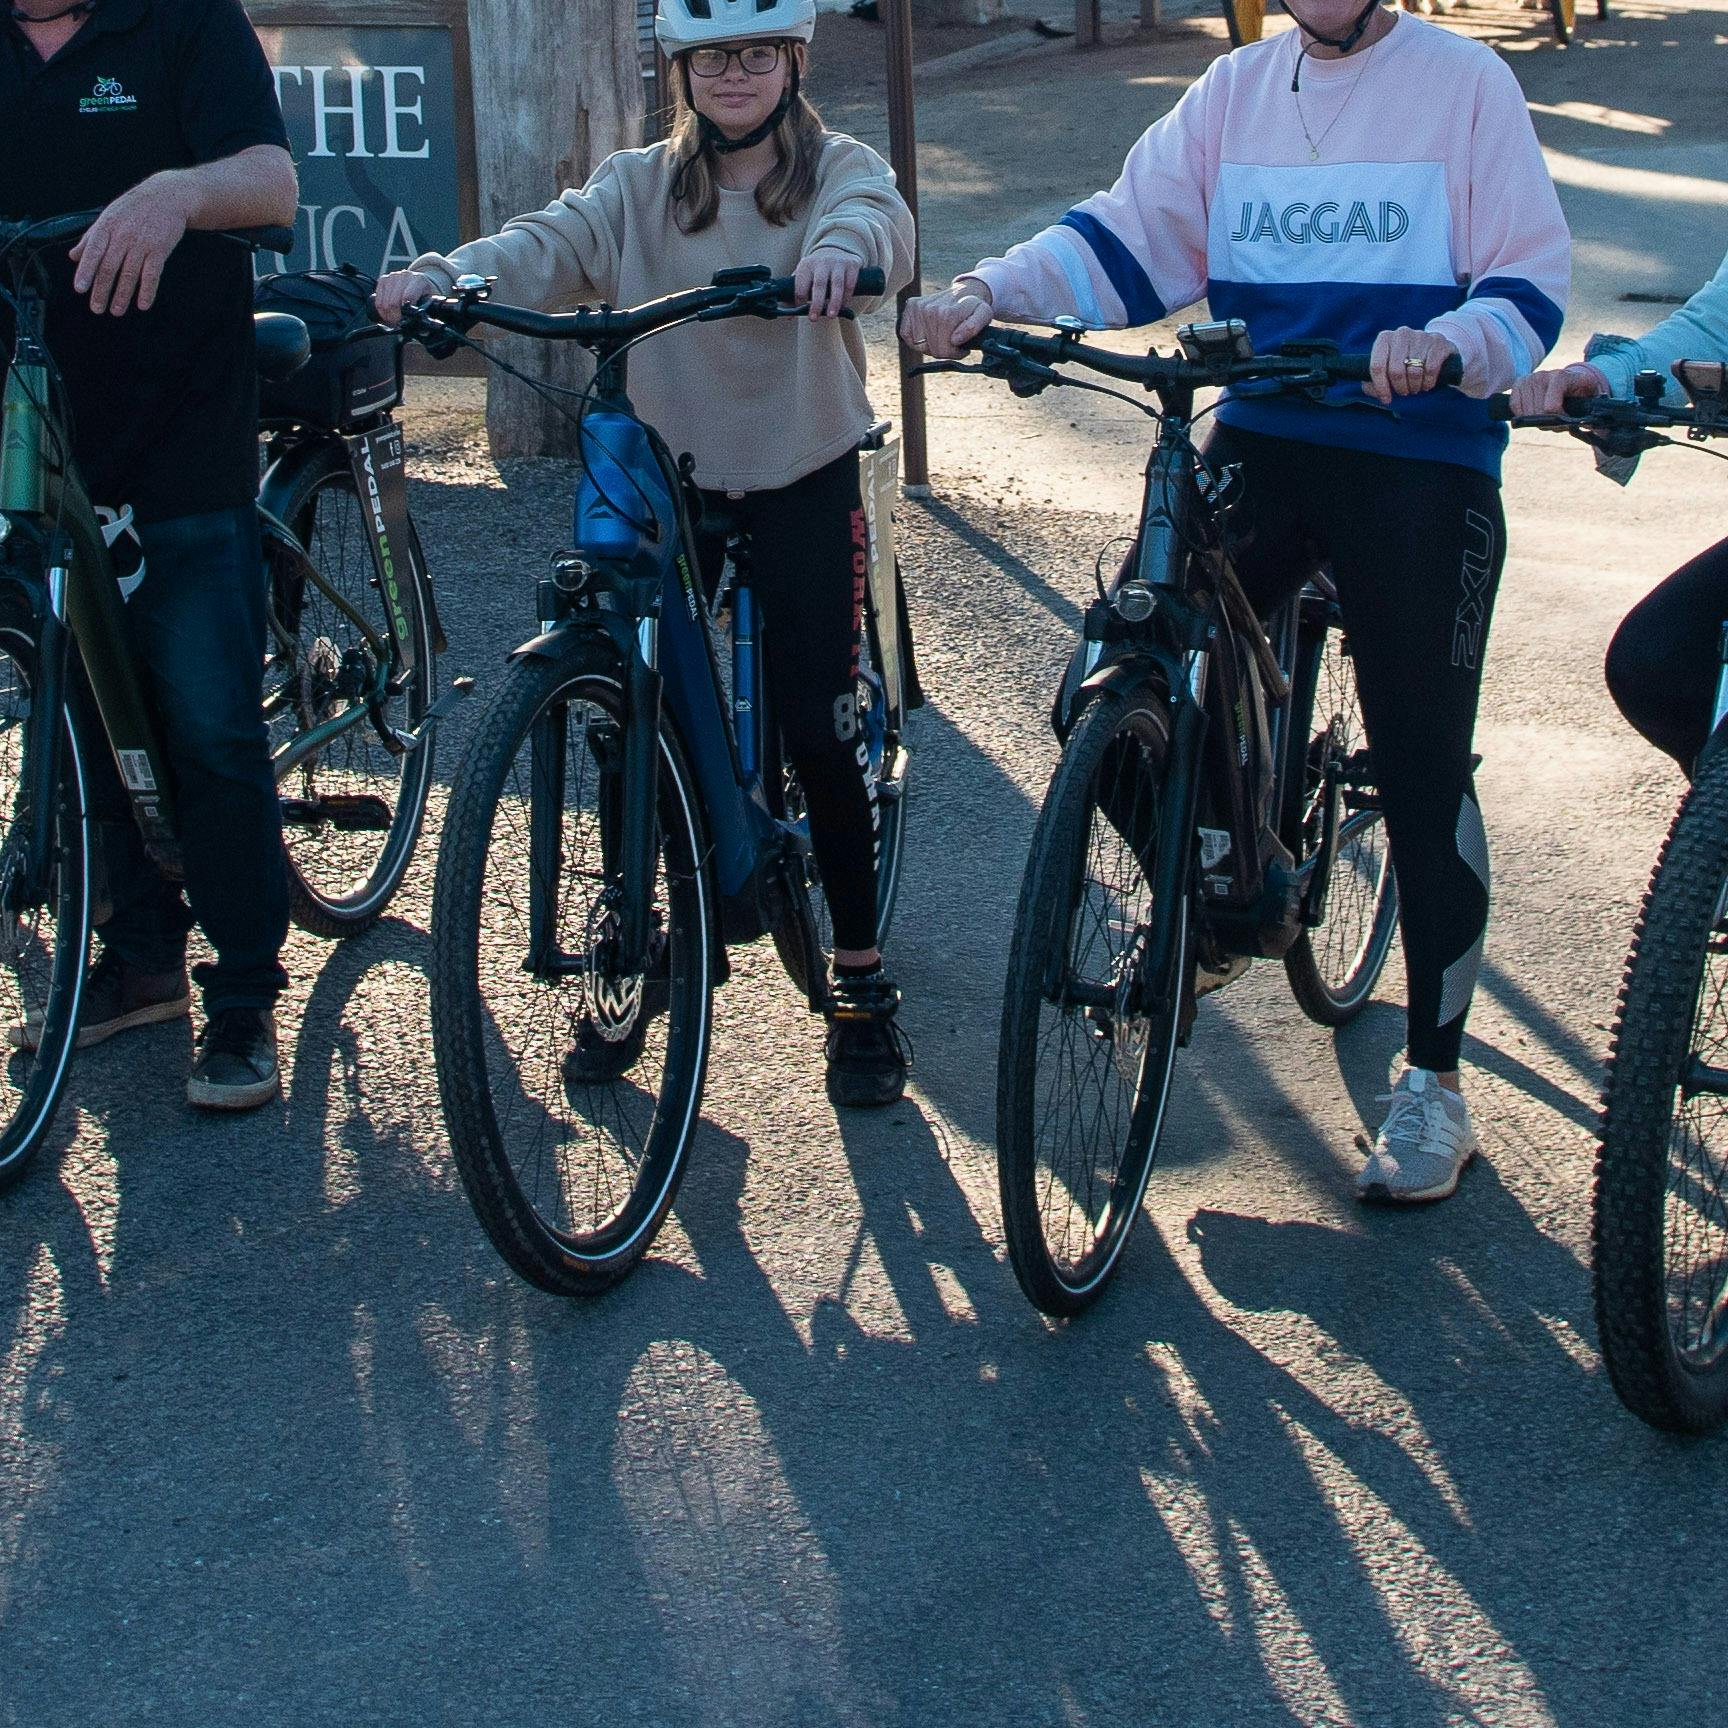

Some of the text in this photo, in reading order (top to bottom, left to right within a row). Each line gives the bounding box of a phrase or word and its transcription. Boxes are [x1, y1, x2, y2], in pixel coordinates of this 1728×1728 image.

[1231, 201, 1410, 244] JAGGAD
[361, 436, 408, 641] greenPEDAL
[1452, 508, 1494, 670] 2XU
